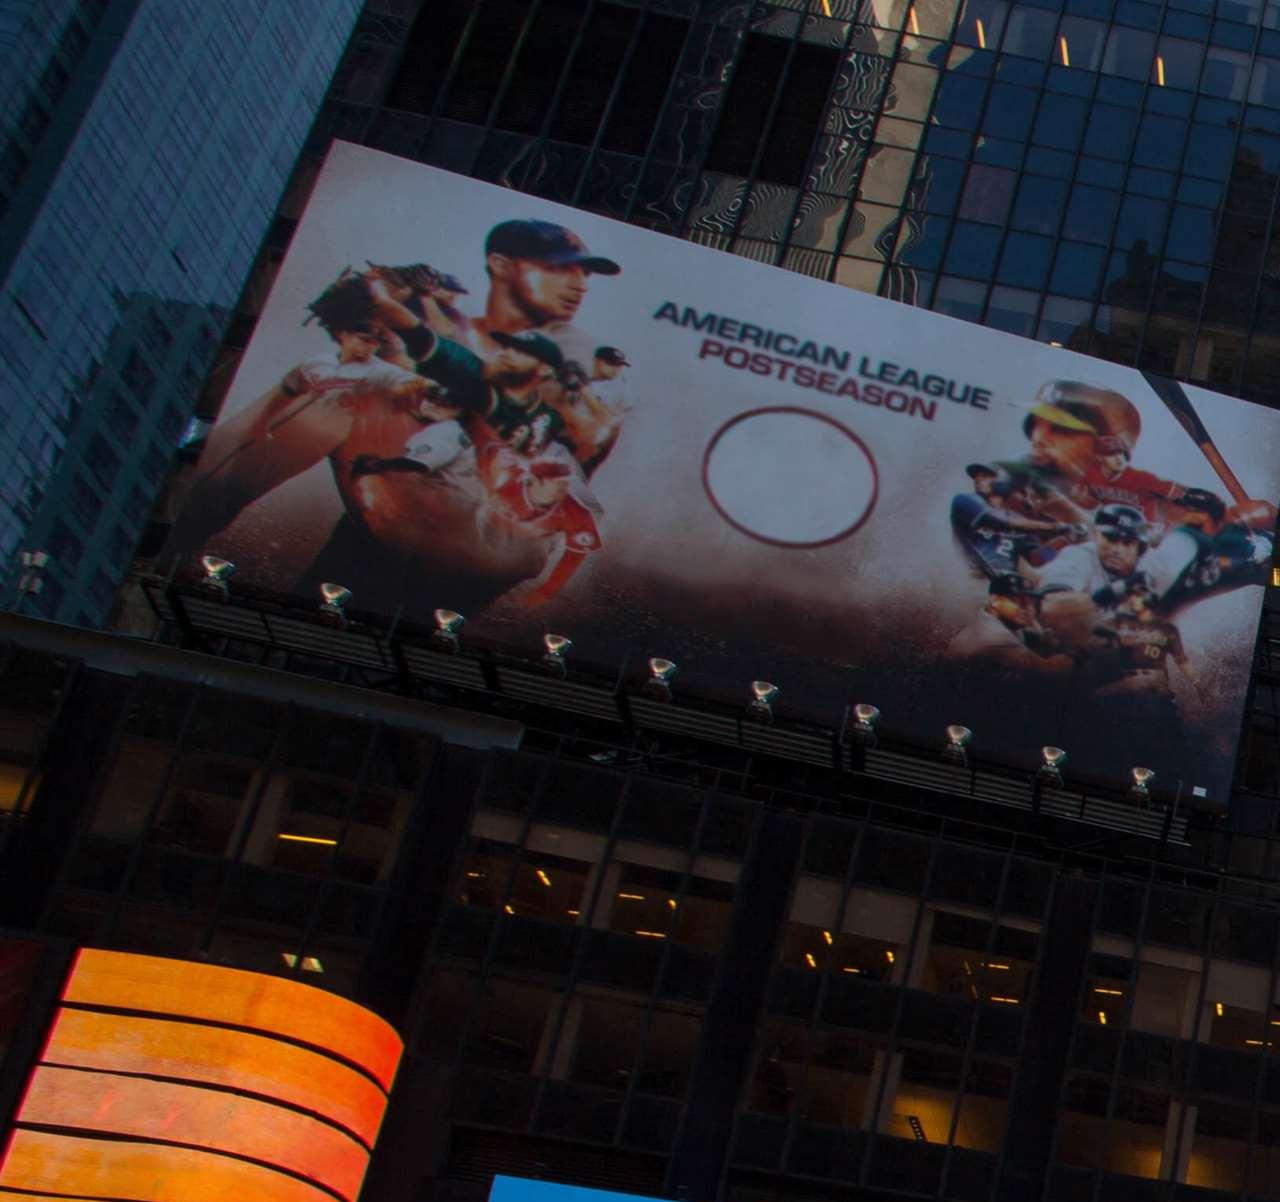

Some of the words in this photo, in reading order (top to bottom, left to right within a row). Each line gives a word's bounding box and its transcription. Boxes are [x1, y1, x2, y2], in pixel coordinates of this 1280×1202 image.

[653, 301, 850, 371] AMERICAN
[857, 357, 993, 410] LEAGUE
[698, 339, 937, 422] POSTSEASON
